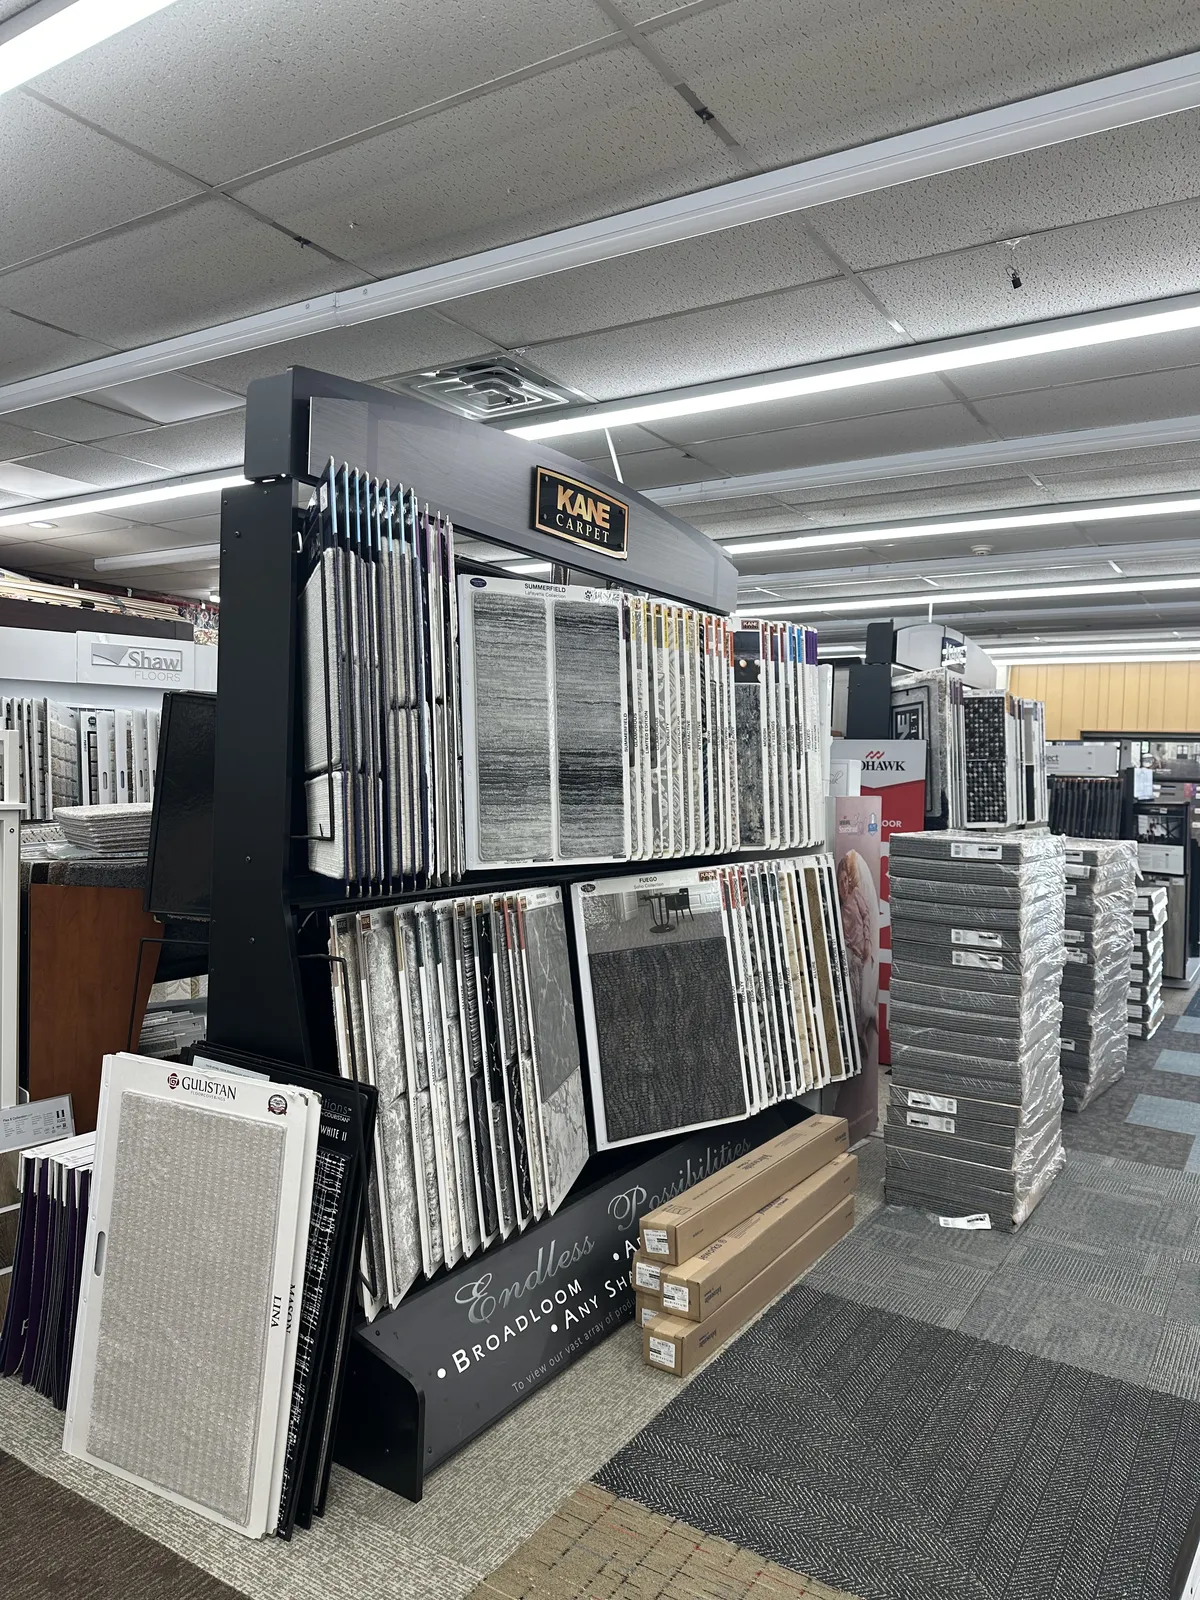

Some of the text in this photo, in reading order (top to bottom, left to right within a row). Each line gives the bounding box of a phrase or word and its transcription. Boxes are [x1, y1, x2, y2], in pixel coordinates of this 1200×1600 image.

[557, 484, 611, 529] KANE
[556, 513, 610, 543] CARPET
[524, 582, 566, 593] SUMMERFIELD
[128, 650, 180, 671] Shaw
[134, 670, 181, 682] FLOORS
[182, 1076, 237, 1100] GULISTAN
[191, 1090, 226, 1102] FLOORCOVERINGS
[320, 1124, 340, 1140] WHITE
[454, 1138, 752, 1325] Endless Possibilities
[270, 1295, 282, 1328] LINA
[286, 1284, 296, 1334] MASON
[564, 1294, 599, 1330] ANY
[451, 1278, 583, 1374] BROADLOOM
[512, 1299, 636, 1393] To view our vast array of produ
